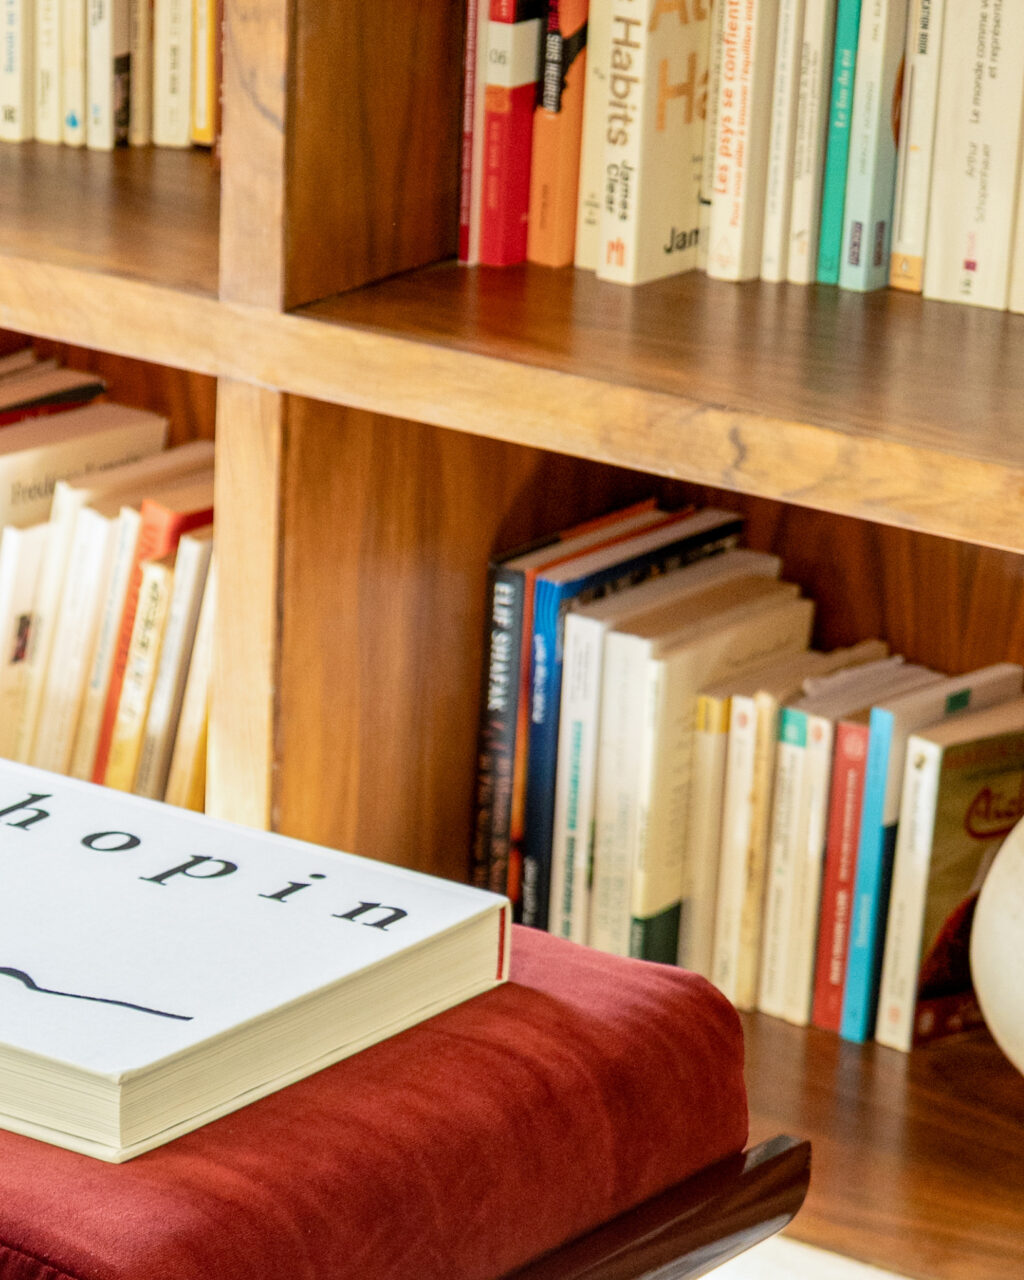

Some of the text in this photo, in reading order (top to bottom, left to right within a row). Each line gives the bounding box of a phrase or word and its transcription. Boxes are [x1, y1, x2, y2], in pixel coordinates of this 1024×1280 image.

[546, 34, 562, 61] SOIS
[976, 13, 988, 58] comme
[607, 14, 642, 147] Habits
[722, 87, 733, 109] se
[971, 61, 984, 106] monde
[718, 114, 734, 158] psys
[969, 109, 980, 125] Le
[713, 164, 729, 195] Les
[966, 141, 976, 178] Arthur
[606, 163, 618, 213] Clear
[618, 160, 635, 221] James
[493, 582, 514, 626] ELIF
